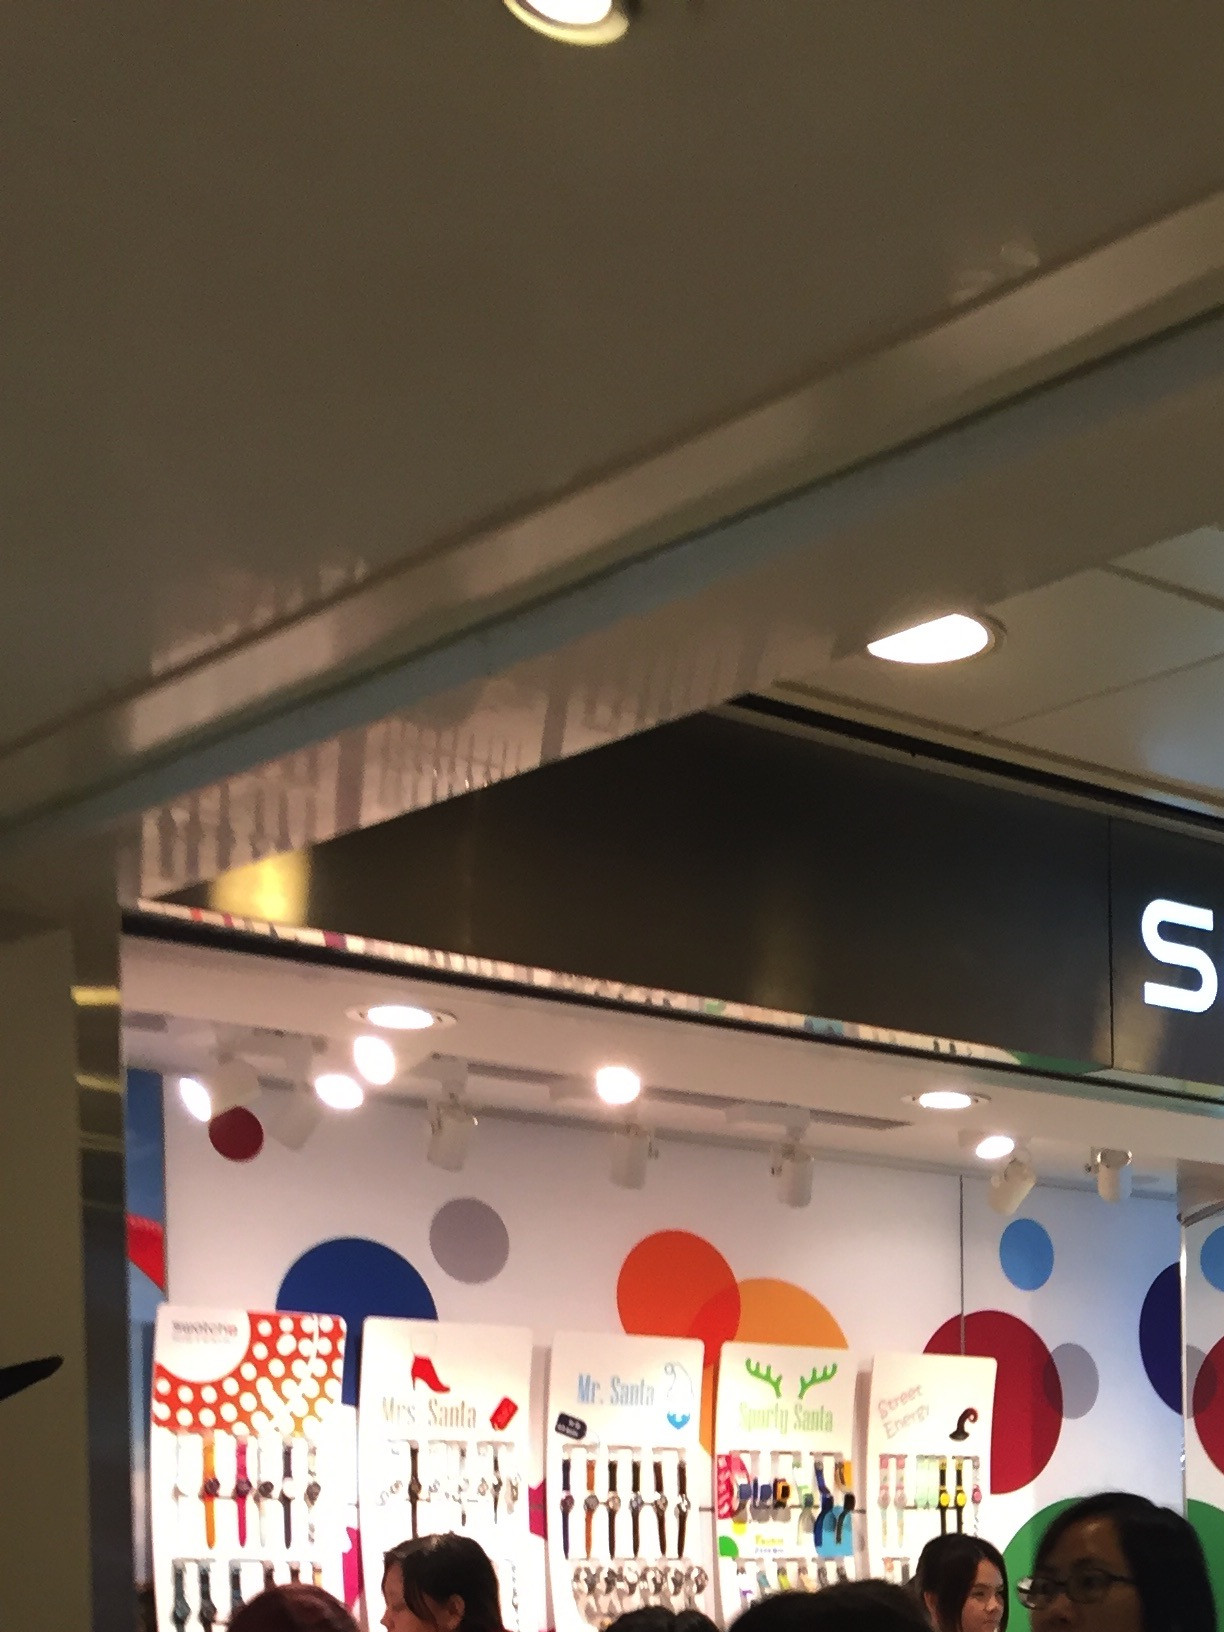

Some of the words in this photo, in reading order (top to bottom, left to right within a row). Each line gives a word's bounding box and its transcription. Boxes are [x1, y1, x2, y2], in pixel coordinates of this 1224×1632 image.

[609, 1375, 655, 1406] Santa
[428, 1398, 477, 1428] Santa
[793, 1403, 833, 1432] Santa
